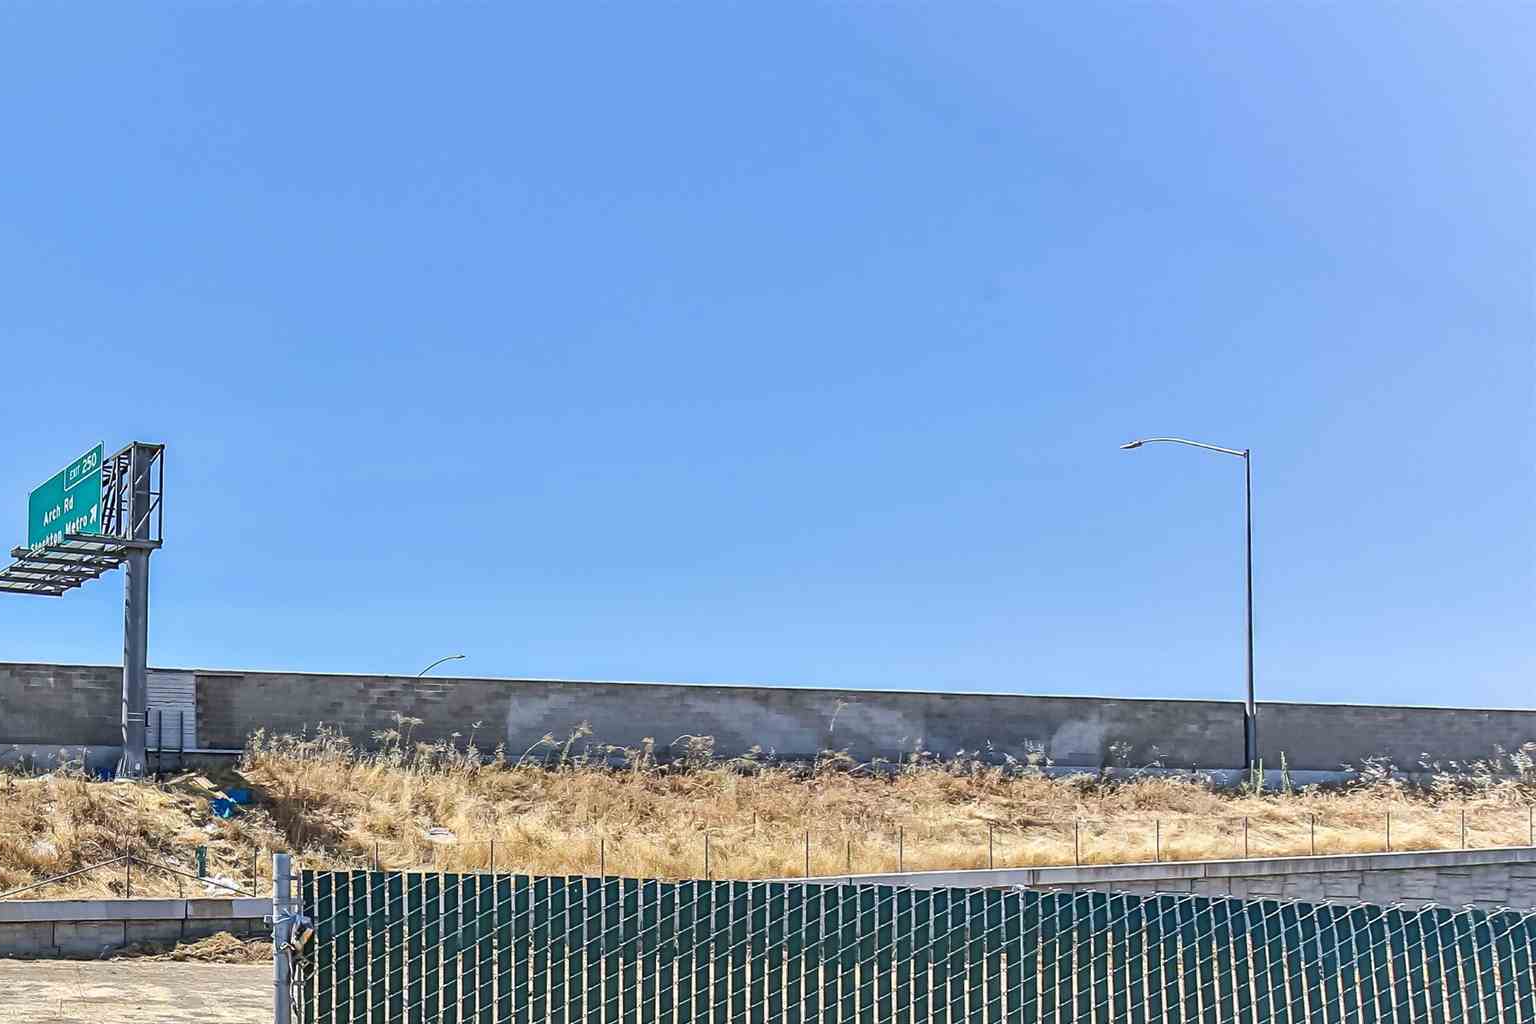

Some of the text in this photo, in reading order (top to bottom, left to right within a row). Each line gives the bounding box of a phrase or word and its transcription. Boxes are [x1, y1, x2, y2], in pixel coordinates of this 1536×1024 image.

[69, 452, 97, 480] EXIT 250
[43, 495, 74, 527] Arch Rd
[65, 514, 88, 534] Metro
